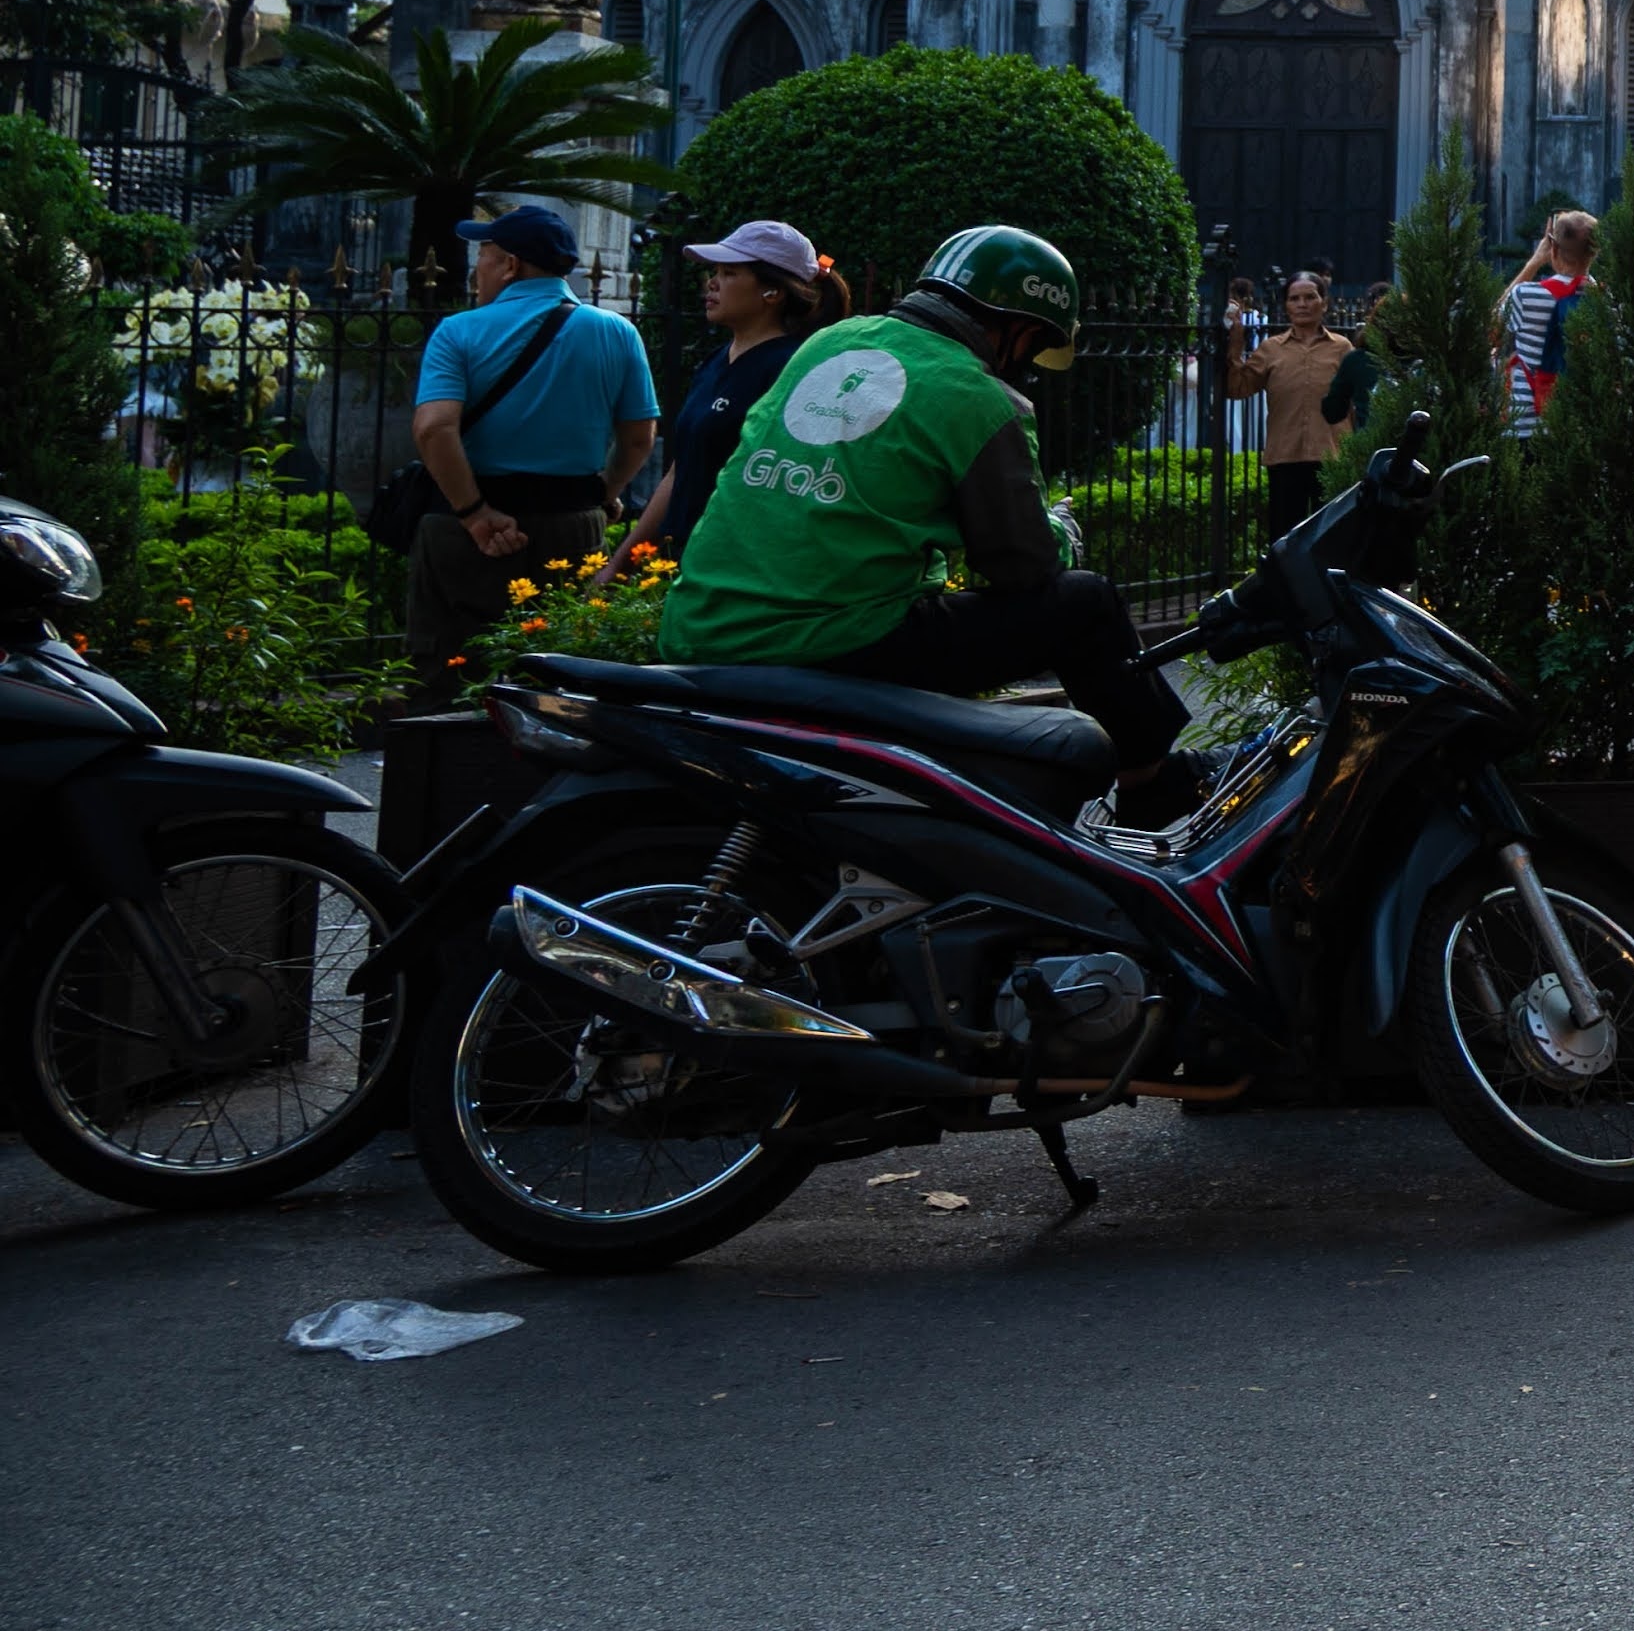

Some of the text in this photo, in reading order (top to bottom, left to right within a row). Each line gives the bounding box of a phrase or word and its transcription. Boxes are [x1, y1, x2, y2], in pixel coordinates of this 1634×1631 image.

[1022, 275, 1070, 309] Grab
[743, 448, 846, 504] Grab
[1350, 692, 1409, 704] HONDA
